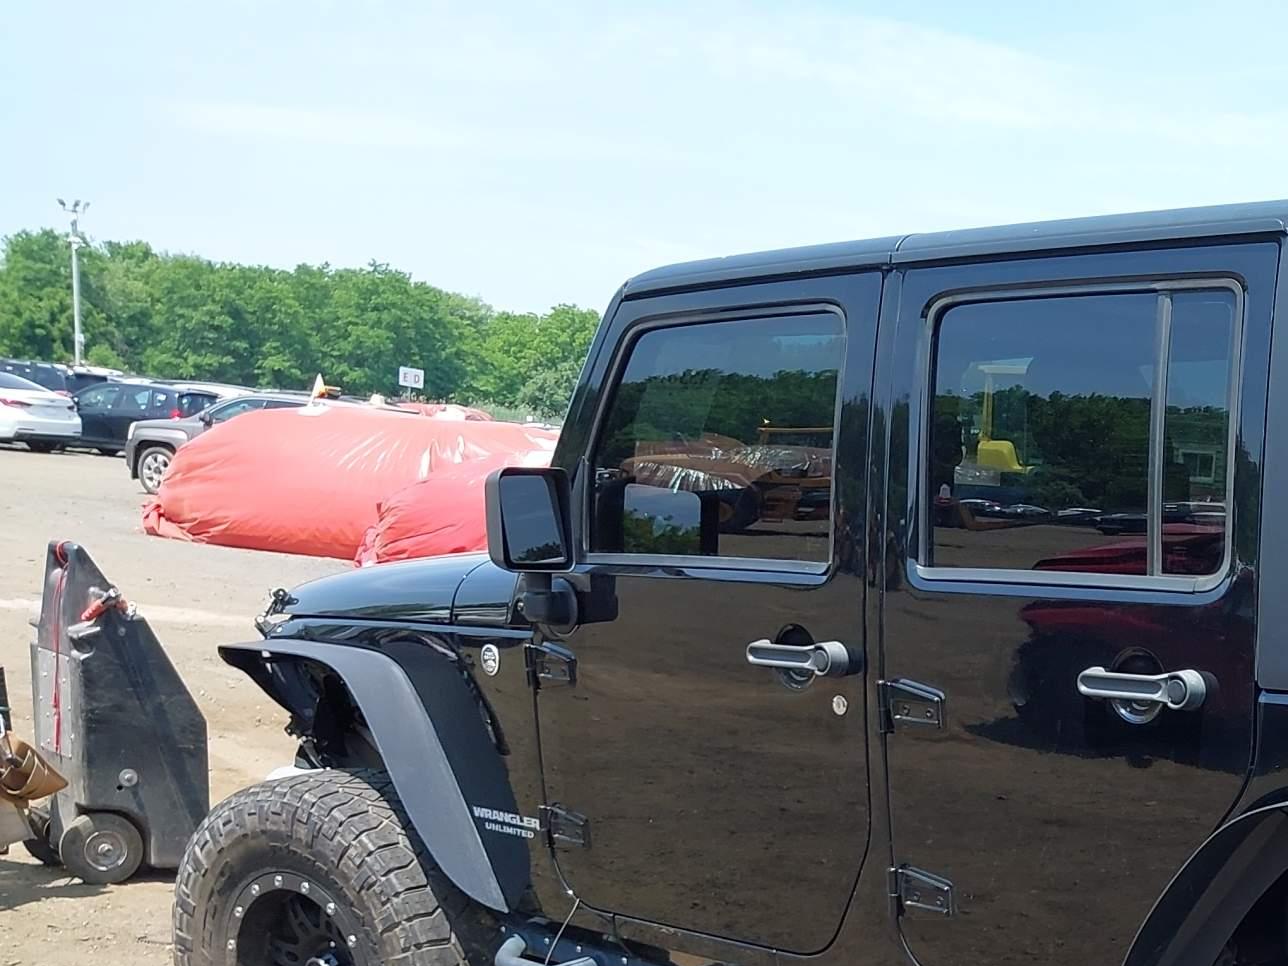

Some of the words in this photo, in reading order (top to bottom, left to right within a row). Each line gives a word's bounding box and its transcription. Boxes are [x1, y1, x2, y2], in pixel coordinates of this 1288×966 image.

[413, 374, 420, 384] D
[472, 806, 540, 831] WRANGLER
[485, 821, 535, 839] UNLIMITED
